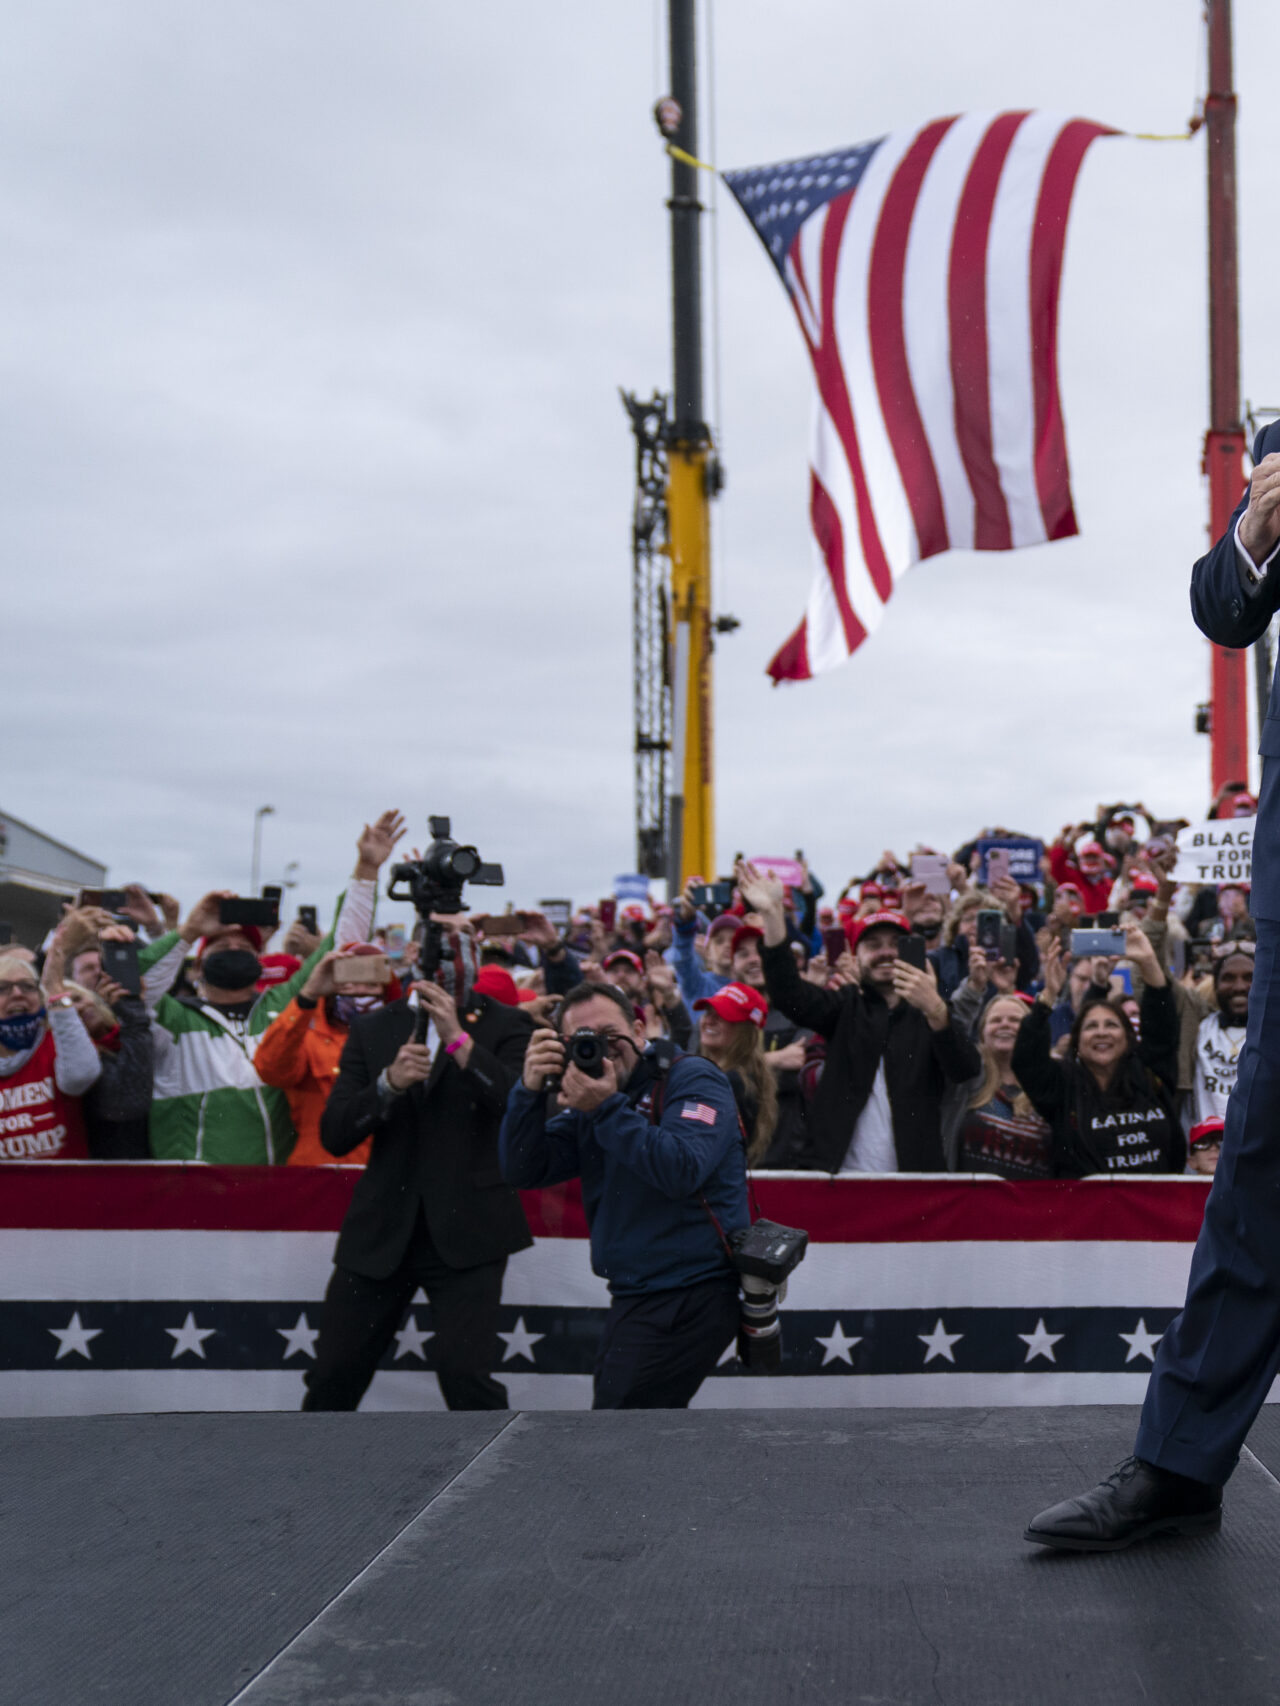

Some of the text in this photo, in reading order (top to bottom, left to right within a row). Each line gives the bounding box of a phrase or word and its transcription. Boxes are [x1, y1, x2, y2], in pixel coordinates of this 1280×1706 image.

[1193, 831, 1250, 847] BLAC
[1217, 849, 1251, 862] FOR
[1091, 1108, 1165, 1130] LATINAS
[1117, 1132, 1149, 1147] FOR
[1106, 1150, 1161, 1169] TRUMP
